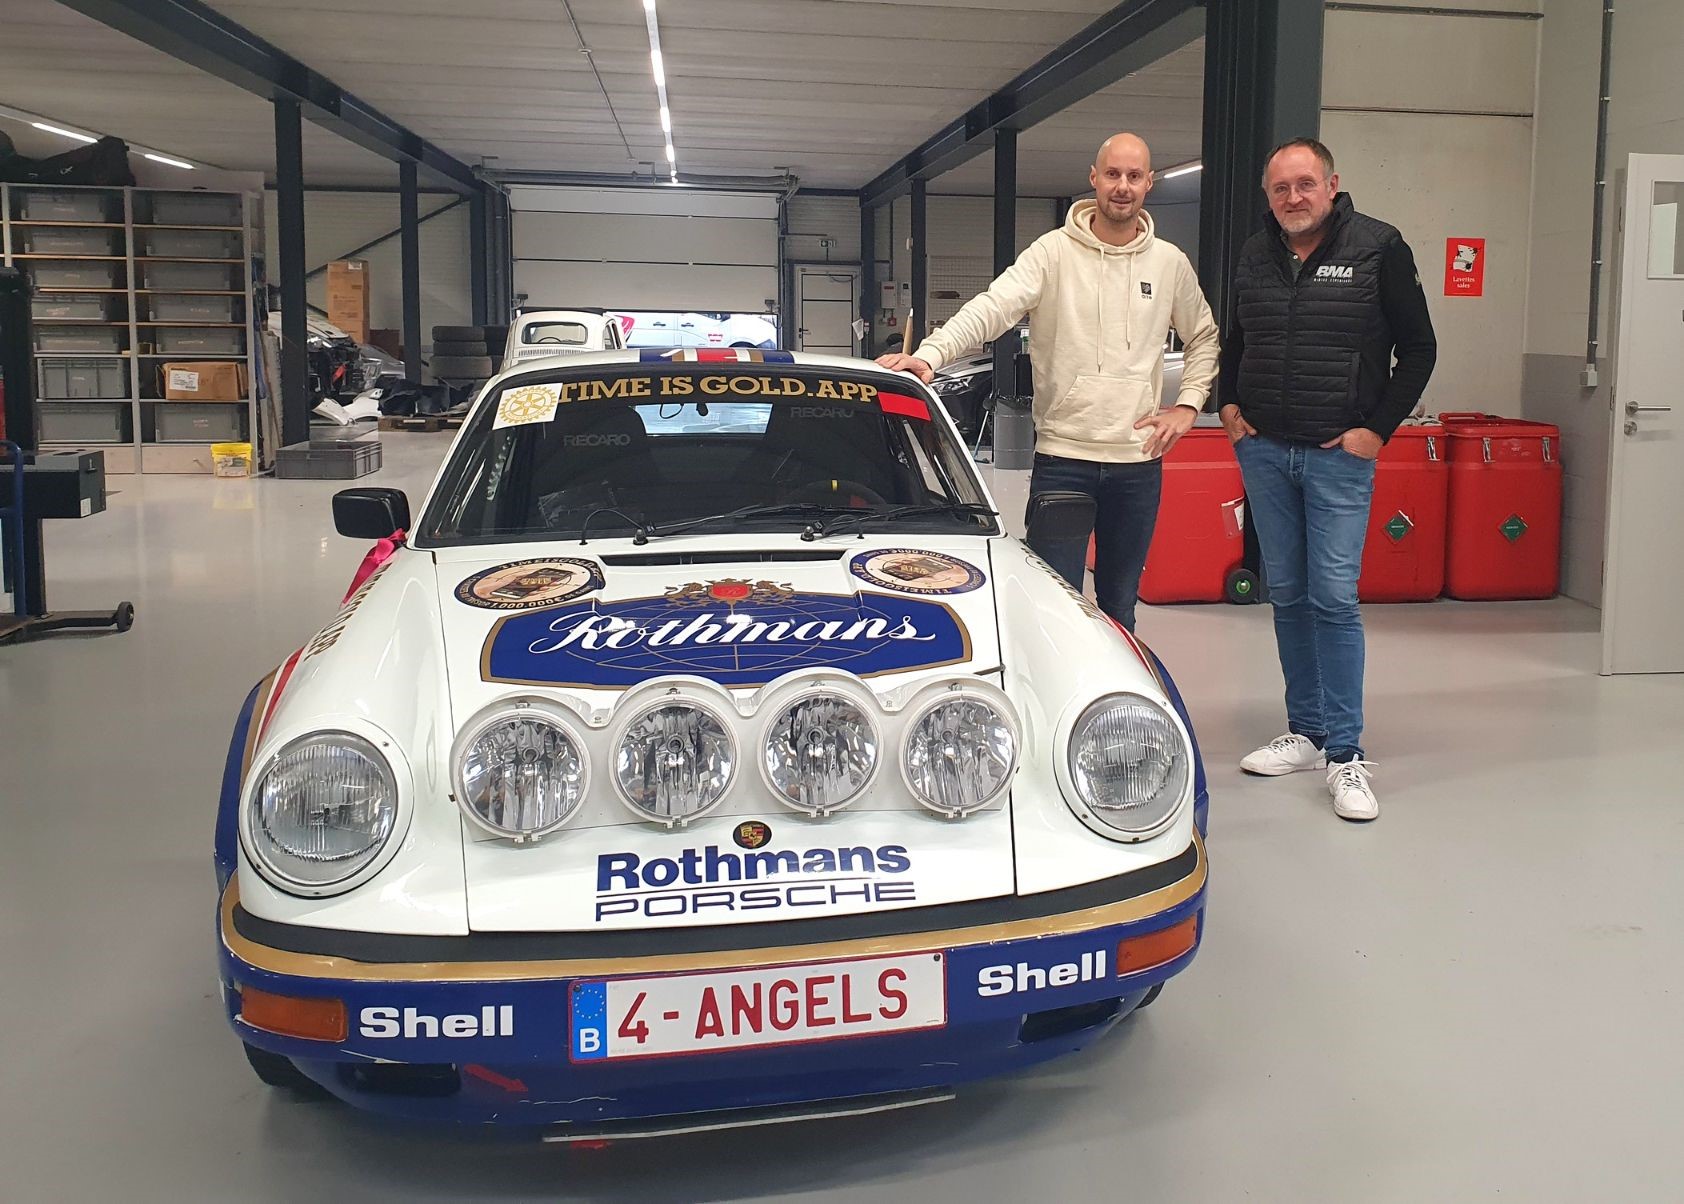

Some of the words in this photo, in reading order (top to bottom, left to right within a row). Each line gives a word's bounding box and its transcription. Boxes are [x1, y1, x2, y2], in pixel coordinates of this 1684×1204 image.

[1316, 265, 1353, 278] BMA
[560, 377, 651, 403] TIME
[660, 376, 694, 395] IS
[699, 376, 878, 402] GOLD.APP
[563, 434, 631, 447] RECARO
[528, 613, 936, 654] Rothmans
[597, 845, 911, 891] Rothmans
[595, 881, 917, 922] PORSCHE
[977, 950, 1106, 997] Shell
[359, 1005, 513, 1038] Shell
[579, 1027, 601, 1053] B
